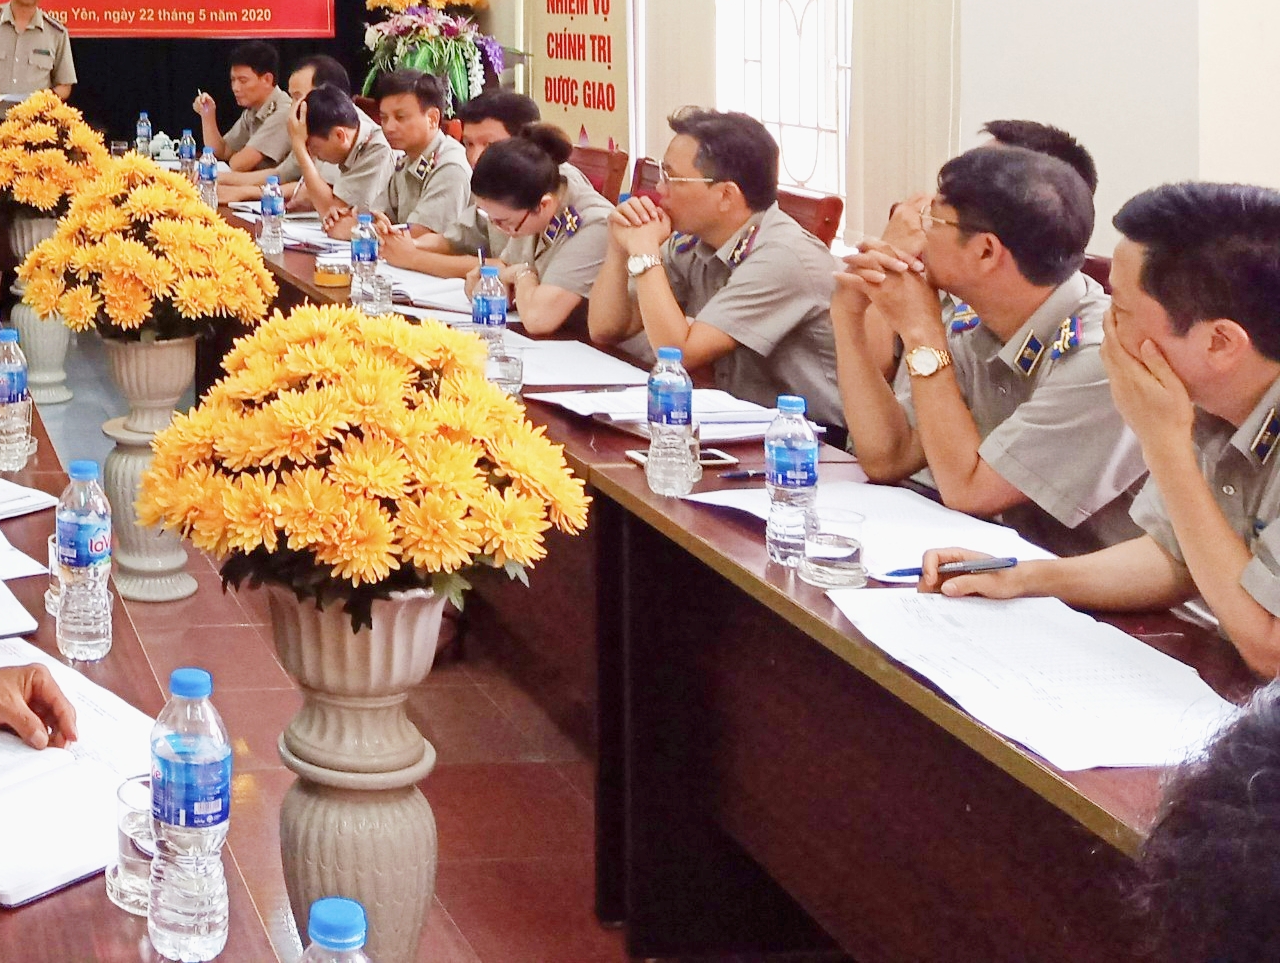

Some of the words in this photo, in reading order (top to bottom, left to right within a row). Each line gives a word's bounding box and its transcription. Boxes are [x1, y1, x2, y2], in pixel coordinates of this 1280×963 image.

[71, 7, 100, 23] Yên,
[104, 7, 136, 24] ngày
[139, 8, 155, 21] 22
[158, 8, 195, 24] tháng
[198, 9, 206, 21] 5
[210, 8, 238, 21] năm
[241, 8, 271, 22] 2020
[547, 28, 586, 61] CHÍNH
[590, 35, 612, 70] TRỊ
[545, 75, 578, 112] ĐƯỢC
[583, 80, 616, 112] GIAO
